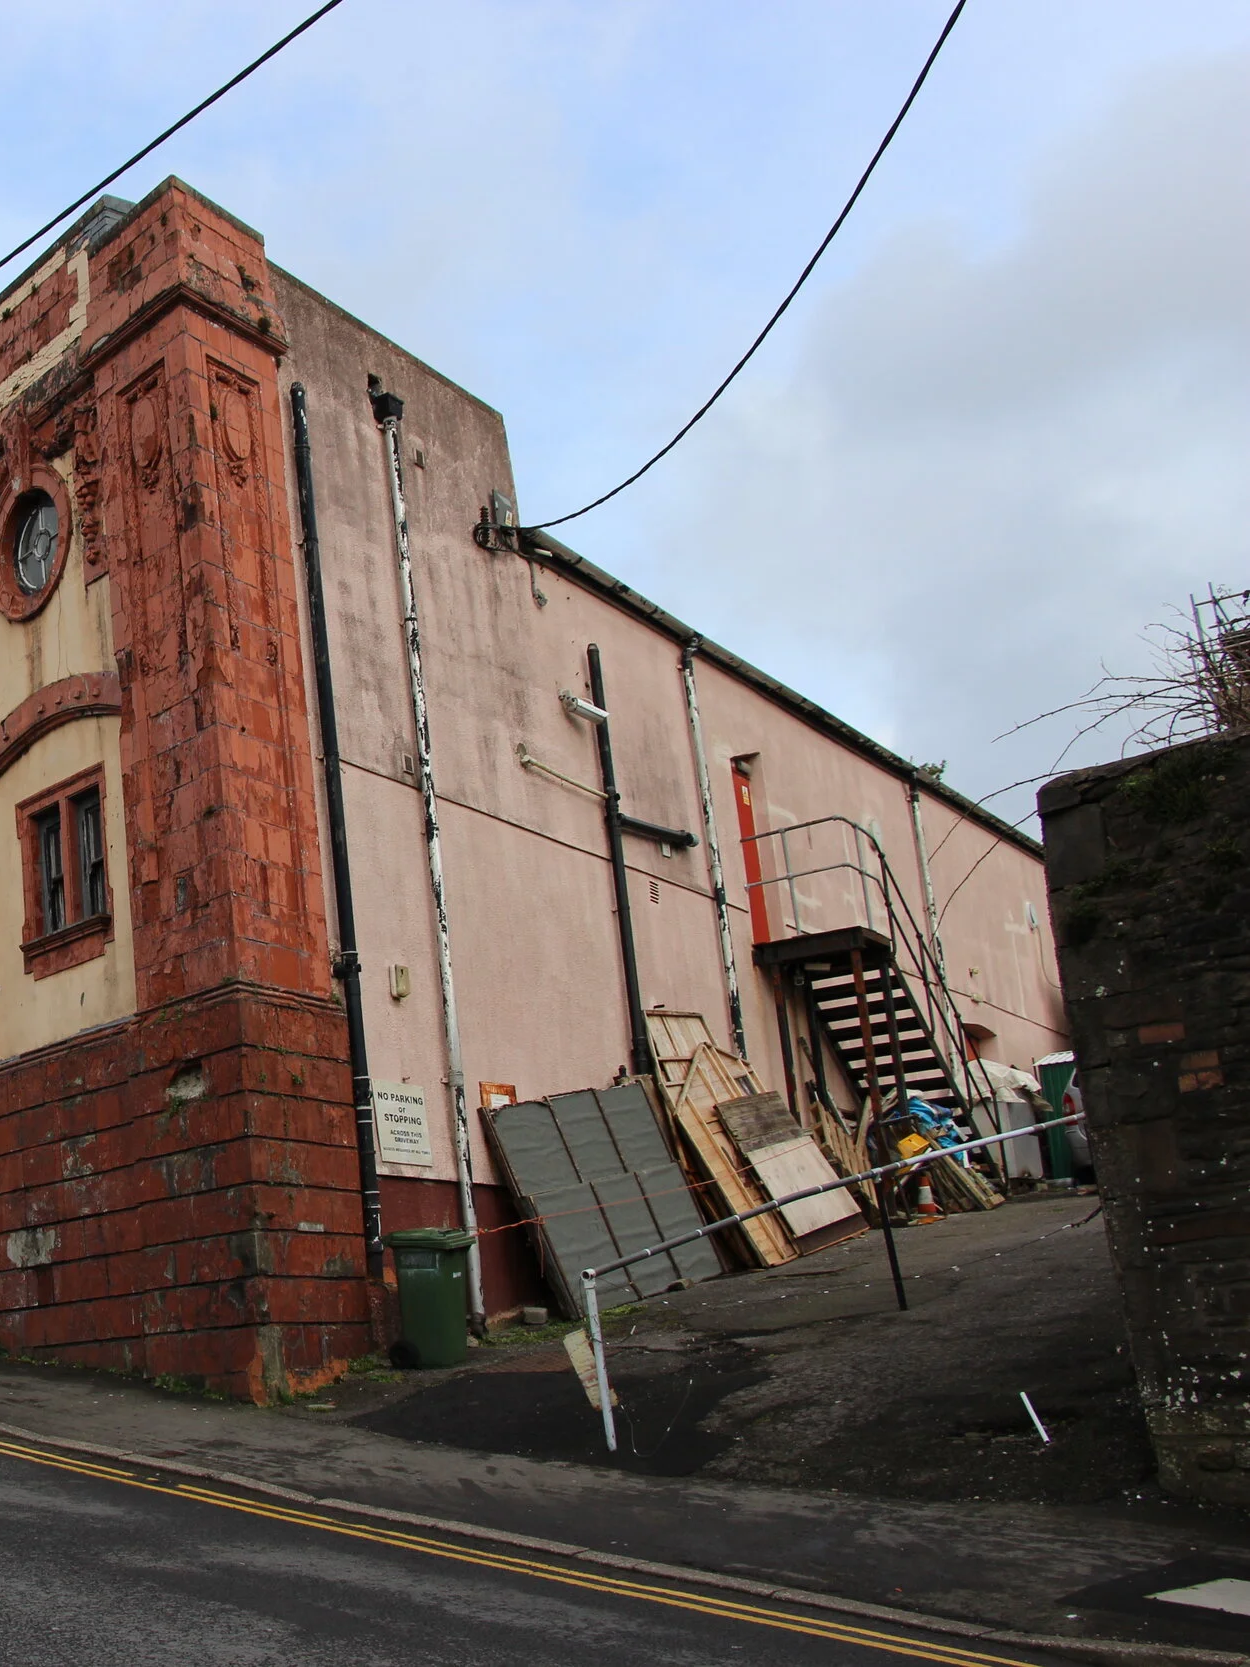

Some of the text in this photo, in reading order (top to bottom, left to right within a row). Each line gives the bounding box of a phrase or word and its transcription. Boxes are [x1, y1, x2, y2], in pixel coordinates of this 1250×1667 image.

[377, 1091, 424, 1106] NO PARKING
[384, 1113, 422, 1126] STOPPING
[390, 1129, 423, 1139] ACROSS THIS
[394, 1136, 419, 1144] DRIVEWAY
